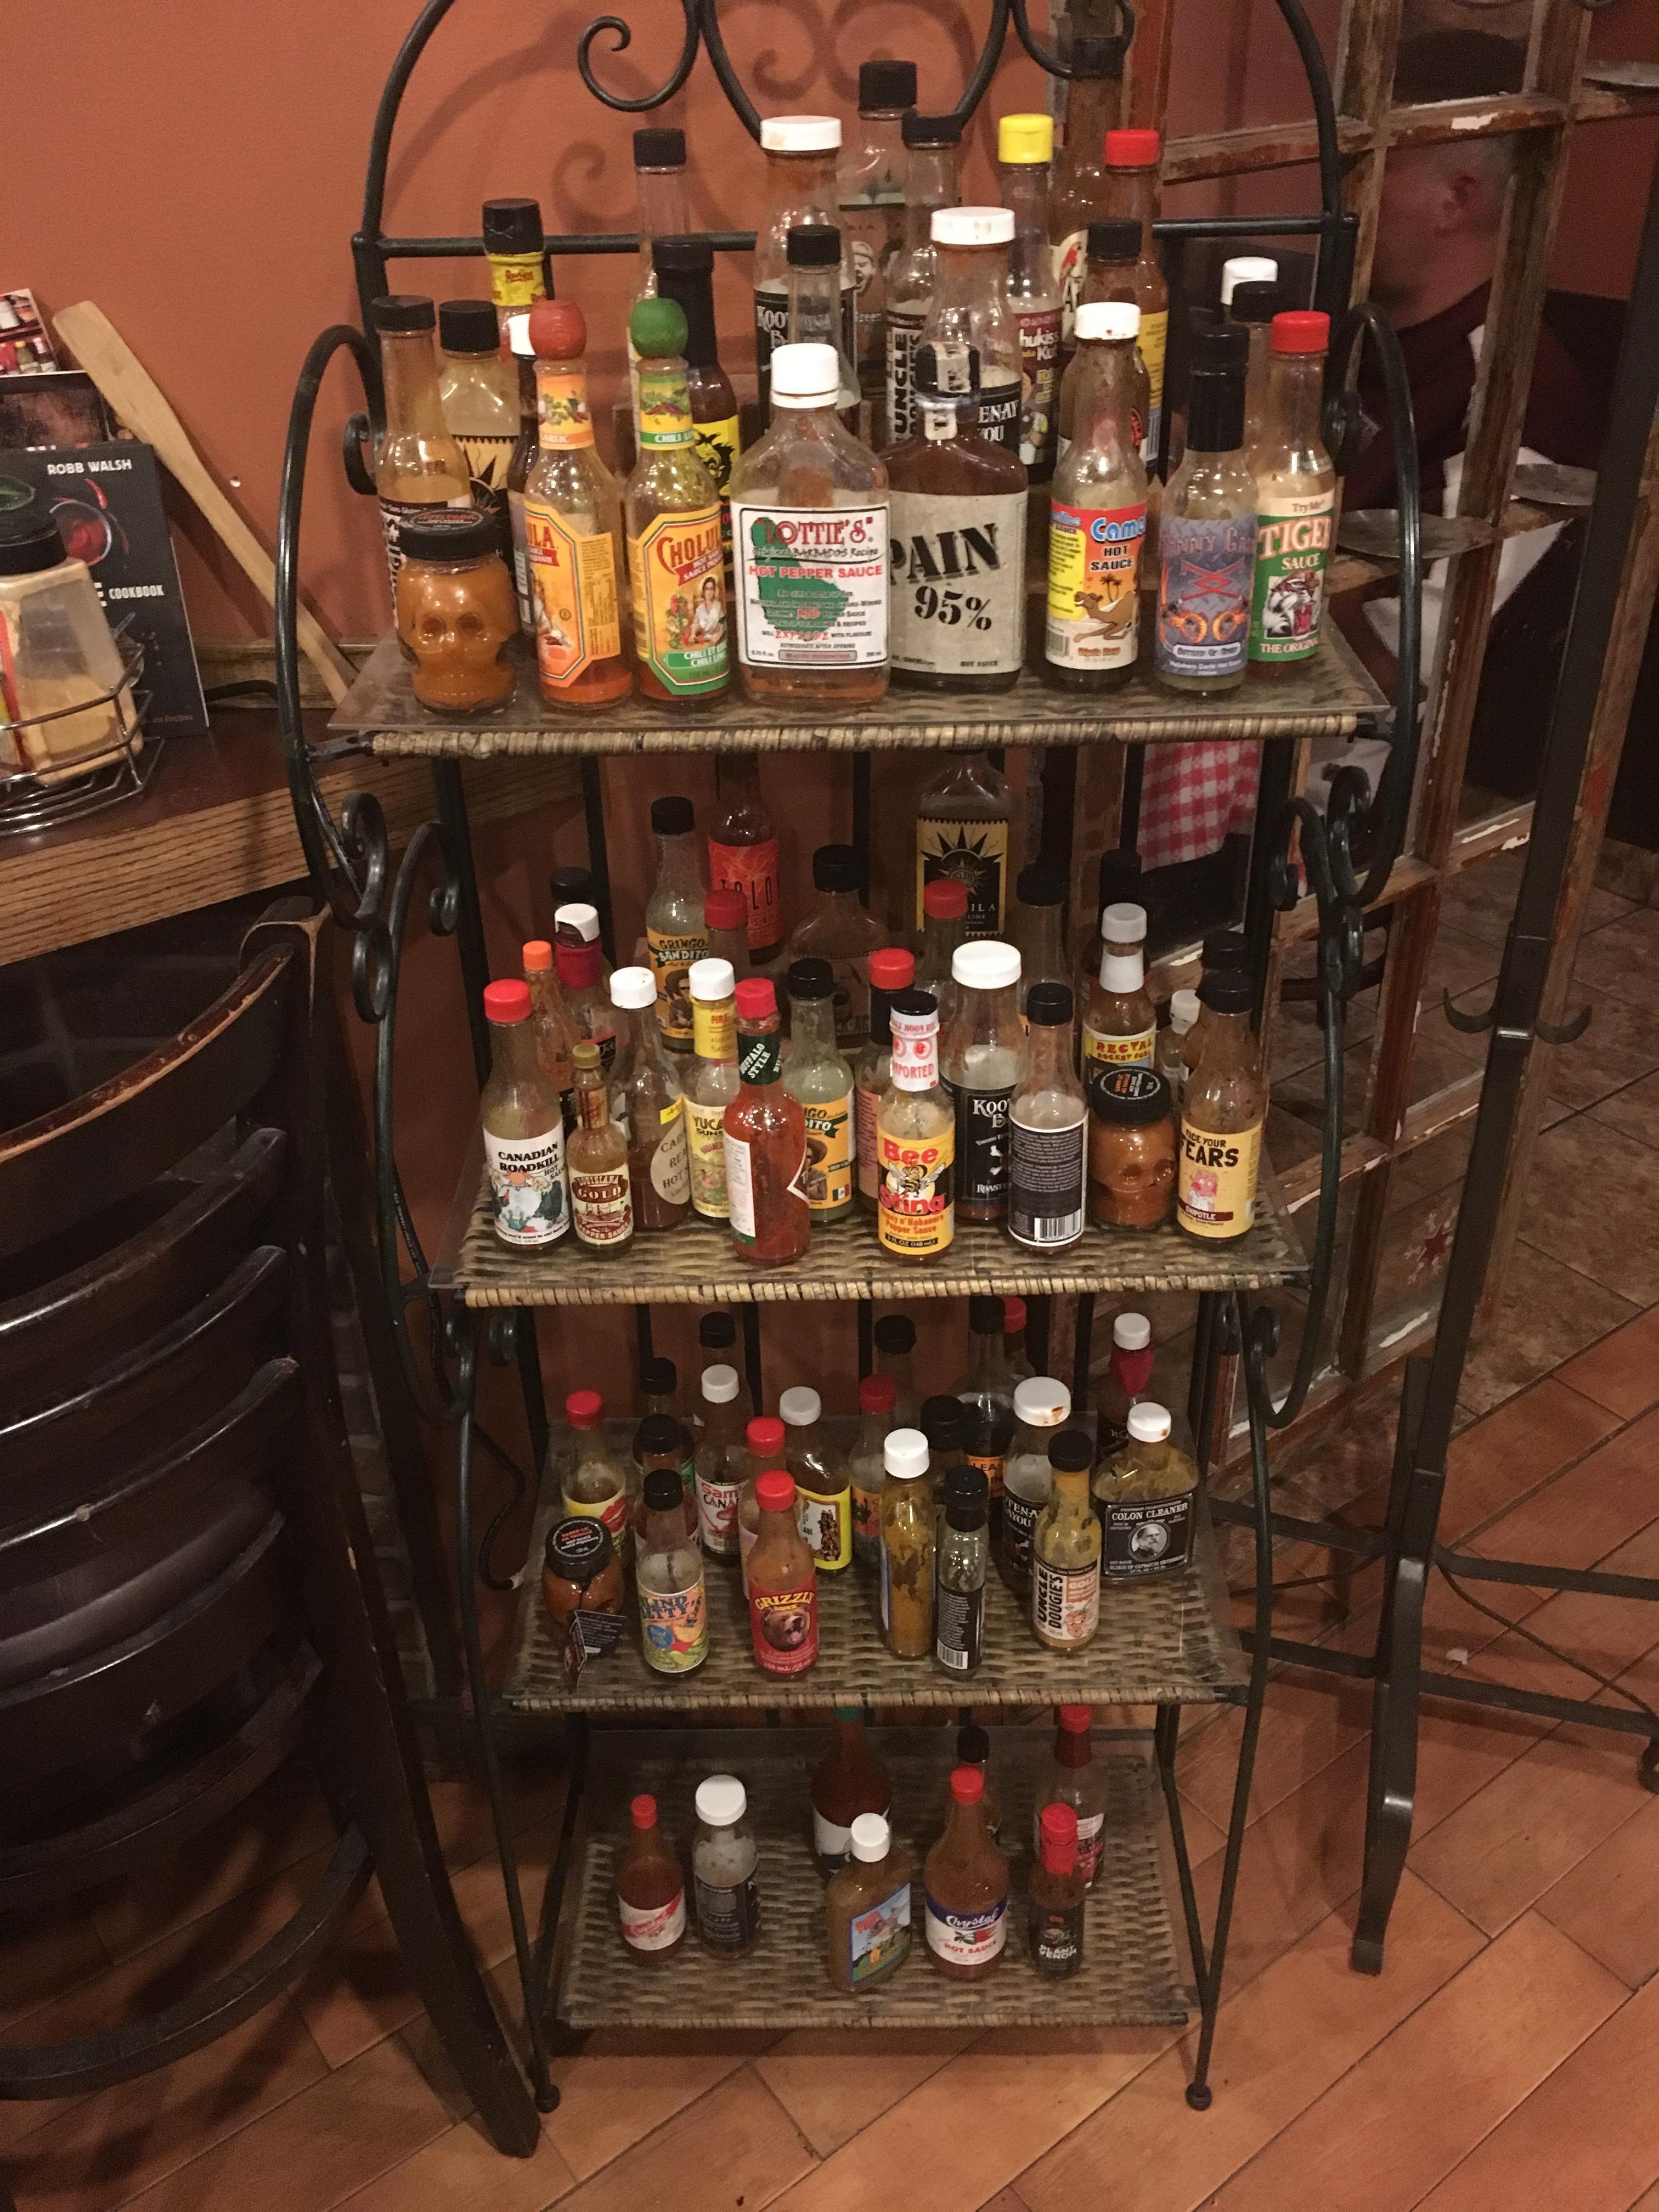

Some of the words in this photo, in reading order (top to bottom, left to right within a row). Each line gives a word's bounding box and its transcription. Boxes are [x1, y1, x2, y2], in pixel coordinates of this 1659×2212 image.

[47, 462, 84, 475] ROBB
[88, 459, 132, 472] WALSH
[890, 523, 1001, 583] PAIN
[1103, 545, 1128, 557] HOT
[1091, 561, 1133, 572] SAUCE
[1281, 553, 1321, 571] SAUCE
[749, 566, 776, 577] HOT
[779, 566, 833, 578] PEPPER
[838, 565, 882, 577] SAUCE
[109, 584, 165, 599] COOKBOOK
[915, 586, 992, 630] 95%
[1262, 643, 1282, 653] THE
[659, 938, 706, 950] GRINGO
[658, 949, 709, 962] BANDITO
[747, 1051, 771, 1079] STYLE
[1203, 1136, 1227, 1148] YOUR
[498, 1142, 558, 1161] CANADIAN
[884, 1138, 938, 1166] Bee
[499, 1153, 559, 1172] ROADKILL
[544, 1164, 558, 1176] HOT
[578, 1186, 623, 1199] GOLD
[880, 1184, 947, 1215] Sting
[1111, 1511, 1143, 1521] COLON
[1146, 1502, 1189, 1519] CLEANER
[755, 1591, 815, 1610] GRIZZLY
[1037, 1567, 1048, 1623] UNCLE
[1048, 1574, 1063, 1629] DOUGIE'S
[946, 1907, 1000, 1928] Crystal
[944, 1943, 964, 1954] HOT
[968, 1939, 997, 1954] SAUCE
